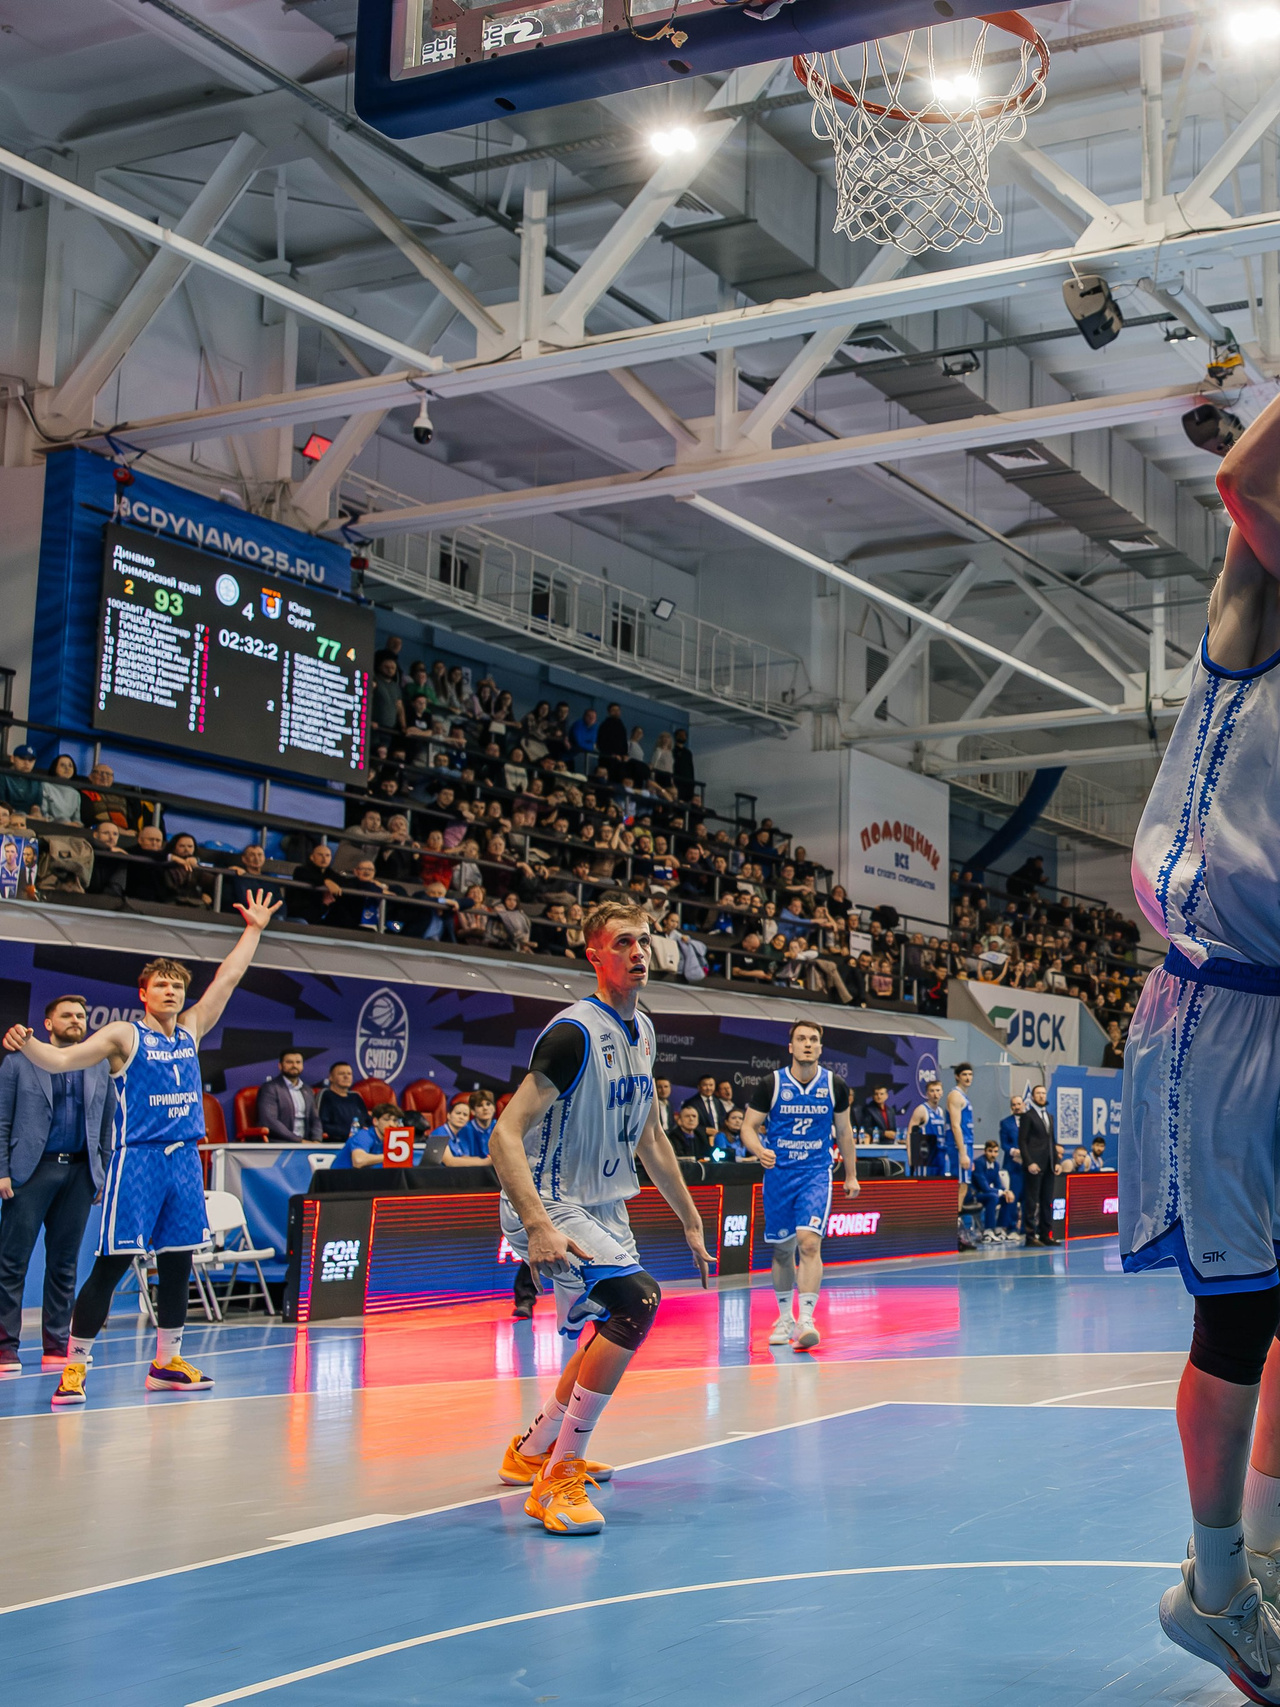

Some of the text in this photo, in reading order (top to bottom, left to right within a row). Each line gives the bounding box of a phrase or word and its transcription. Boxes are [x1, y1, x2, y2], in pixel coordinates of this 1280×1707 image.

[113, 545, 155, 568] Динамо
[113, 558, 202, 597] Приморский край
[124, 579, 135, 595] 2
[154, 588, 184, 616] 93
[106, 607, 111, 616] 1
[241, 603, 255, 621] 4
[218, 628, 278, 662] 02:32:2
[316, 636, 356, 662] 77 4
[213, 685, 220, 698] 1
[266, 699, 275, 712] 2
[860, 819, 940, 871] ПОМОЩНИК
[365, 1048, 398, 1069] СУПЕР
[172, 1063, 181, 1086] 1
[168, 1104, 190, 1119] КРАЙ
[779, 1104, 829, 1115] ДИНАМО
[792, 1117, 813, 1136] 27
[387, 1130, 410, 1163] 5
[724, 1215, 748, 1232] FON
[827, 1211, 881, 1237] FONBET
[723, 1230, 748, 1247] BET
[1202, 1250, 1227, 1264] STK
